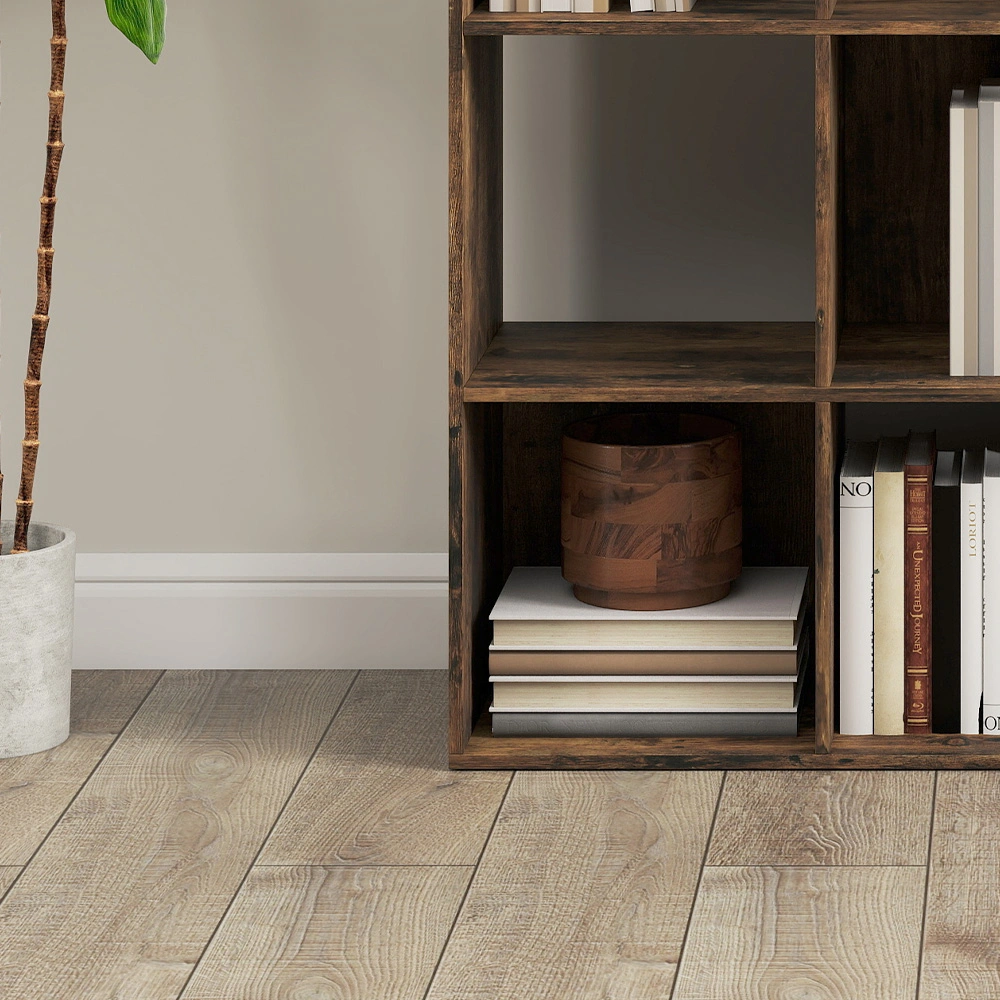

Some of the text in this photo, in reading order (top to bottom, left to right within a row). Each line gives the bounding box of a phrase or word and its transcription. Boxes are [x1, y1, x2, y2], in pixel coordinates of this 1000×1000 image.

[840, 481, 872, 497] NO
[968, 501, 977, 557] LORIOT
[912, 550, 923, 613] UNEXPECTED
[910, 612, 924, 655] JOURNEY
